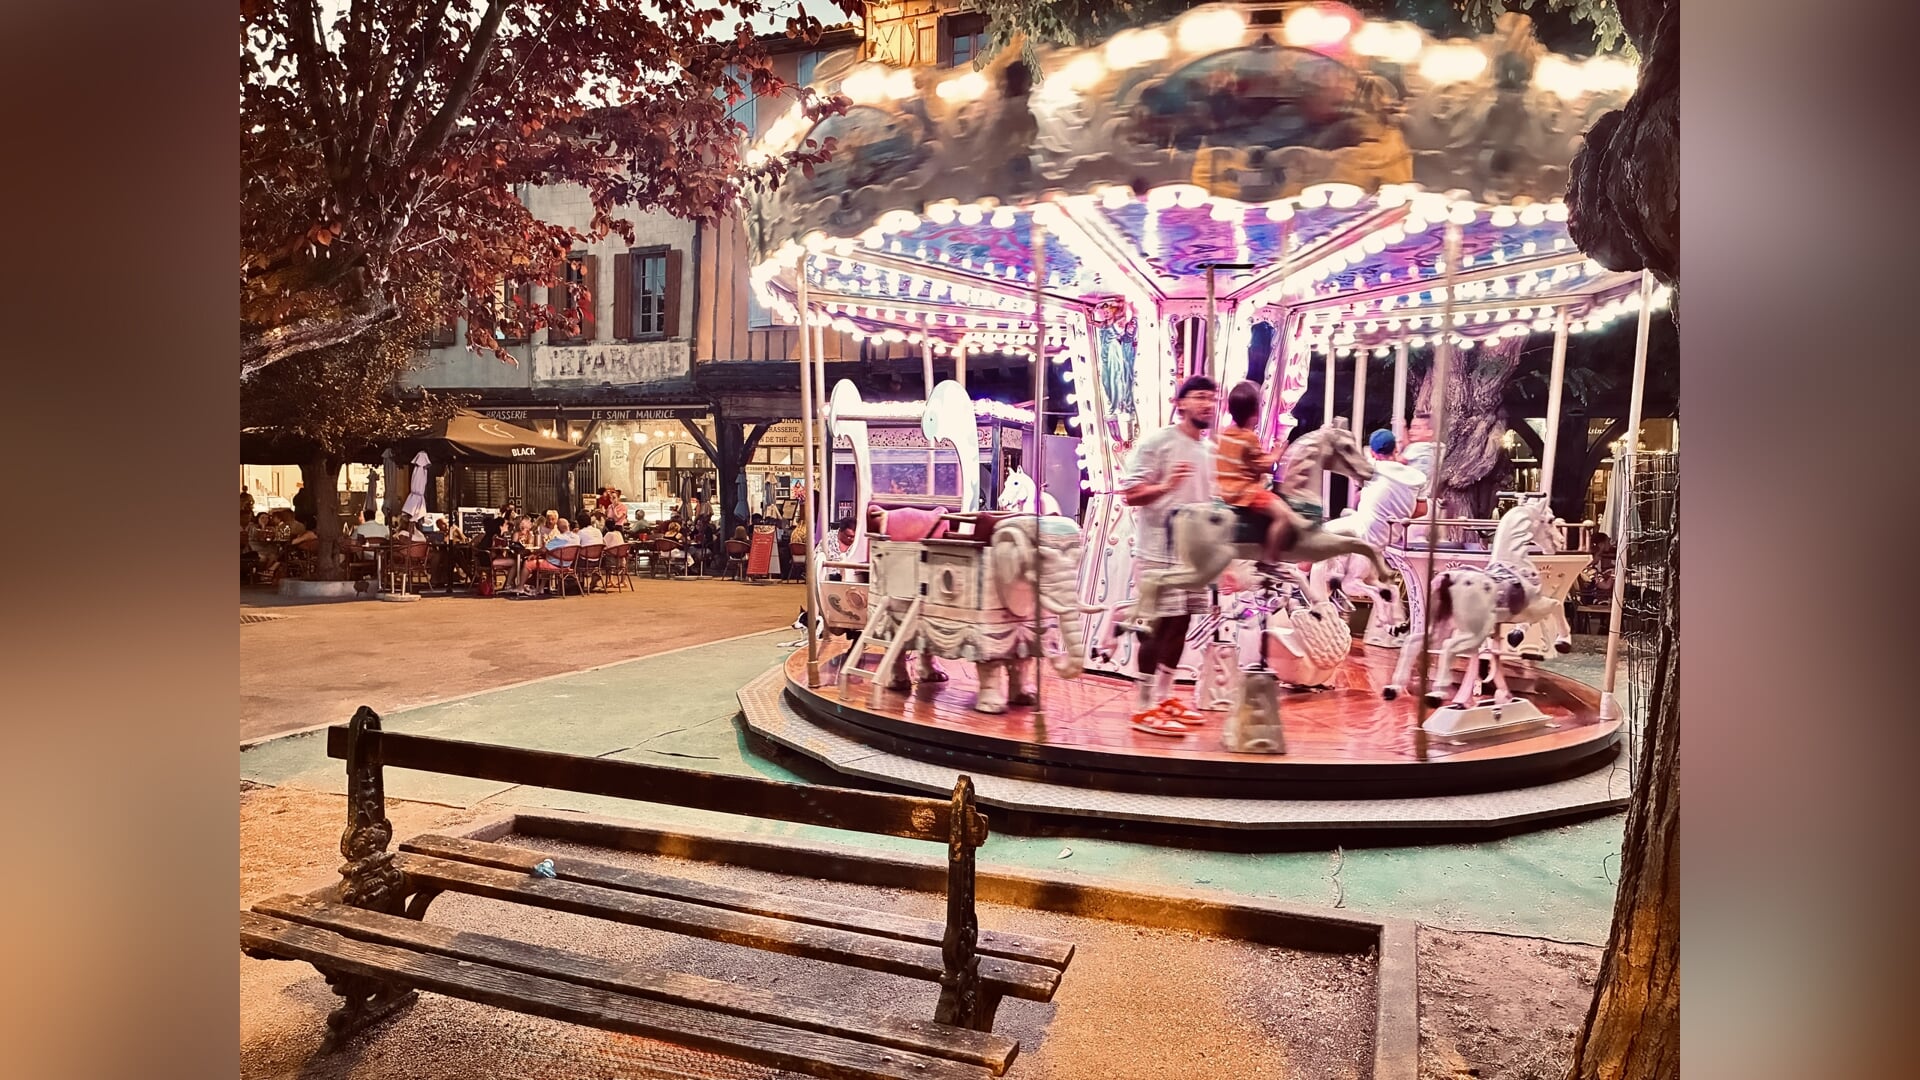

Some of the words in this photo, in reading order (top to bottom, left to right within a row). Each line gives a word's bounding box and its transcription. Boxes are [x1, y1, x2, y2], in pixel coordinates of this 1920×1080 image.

[486, 410, 528, 420] BRASSERIE
[592, 411, 602, 419] LE
[606, 410, 631, 420] SAINT
[636, 410, 675, 419] MAURICE
[511, 447, 536, 457] BLACK
